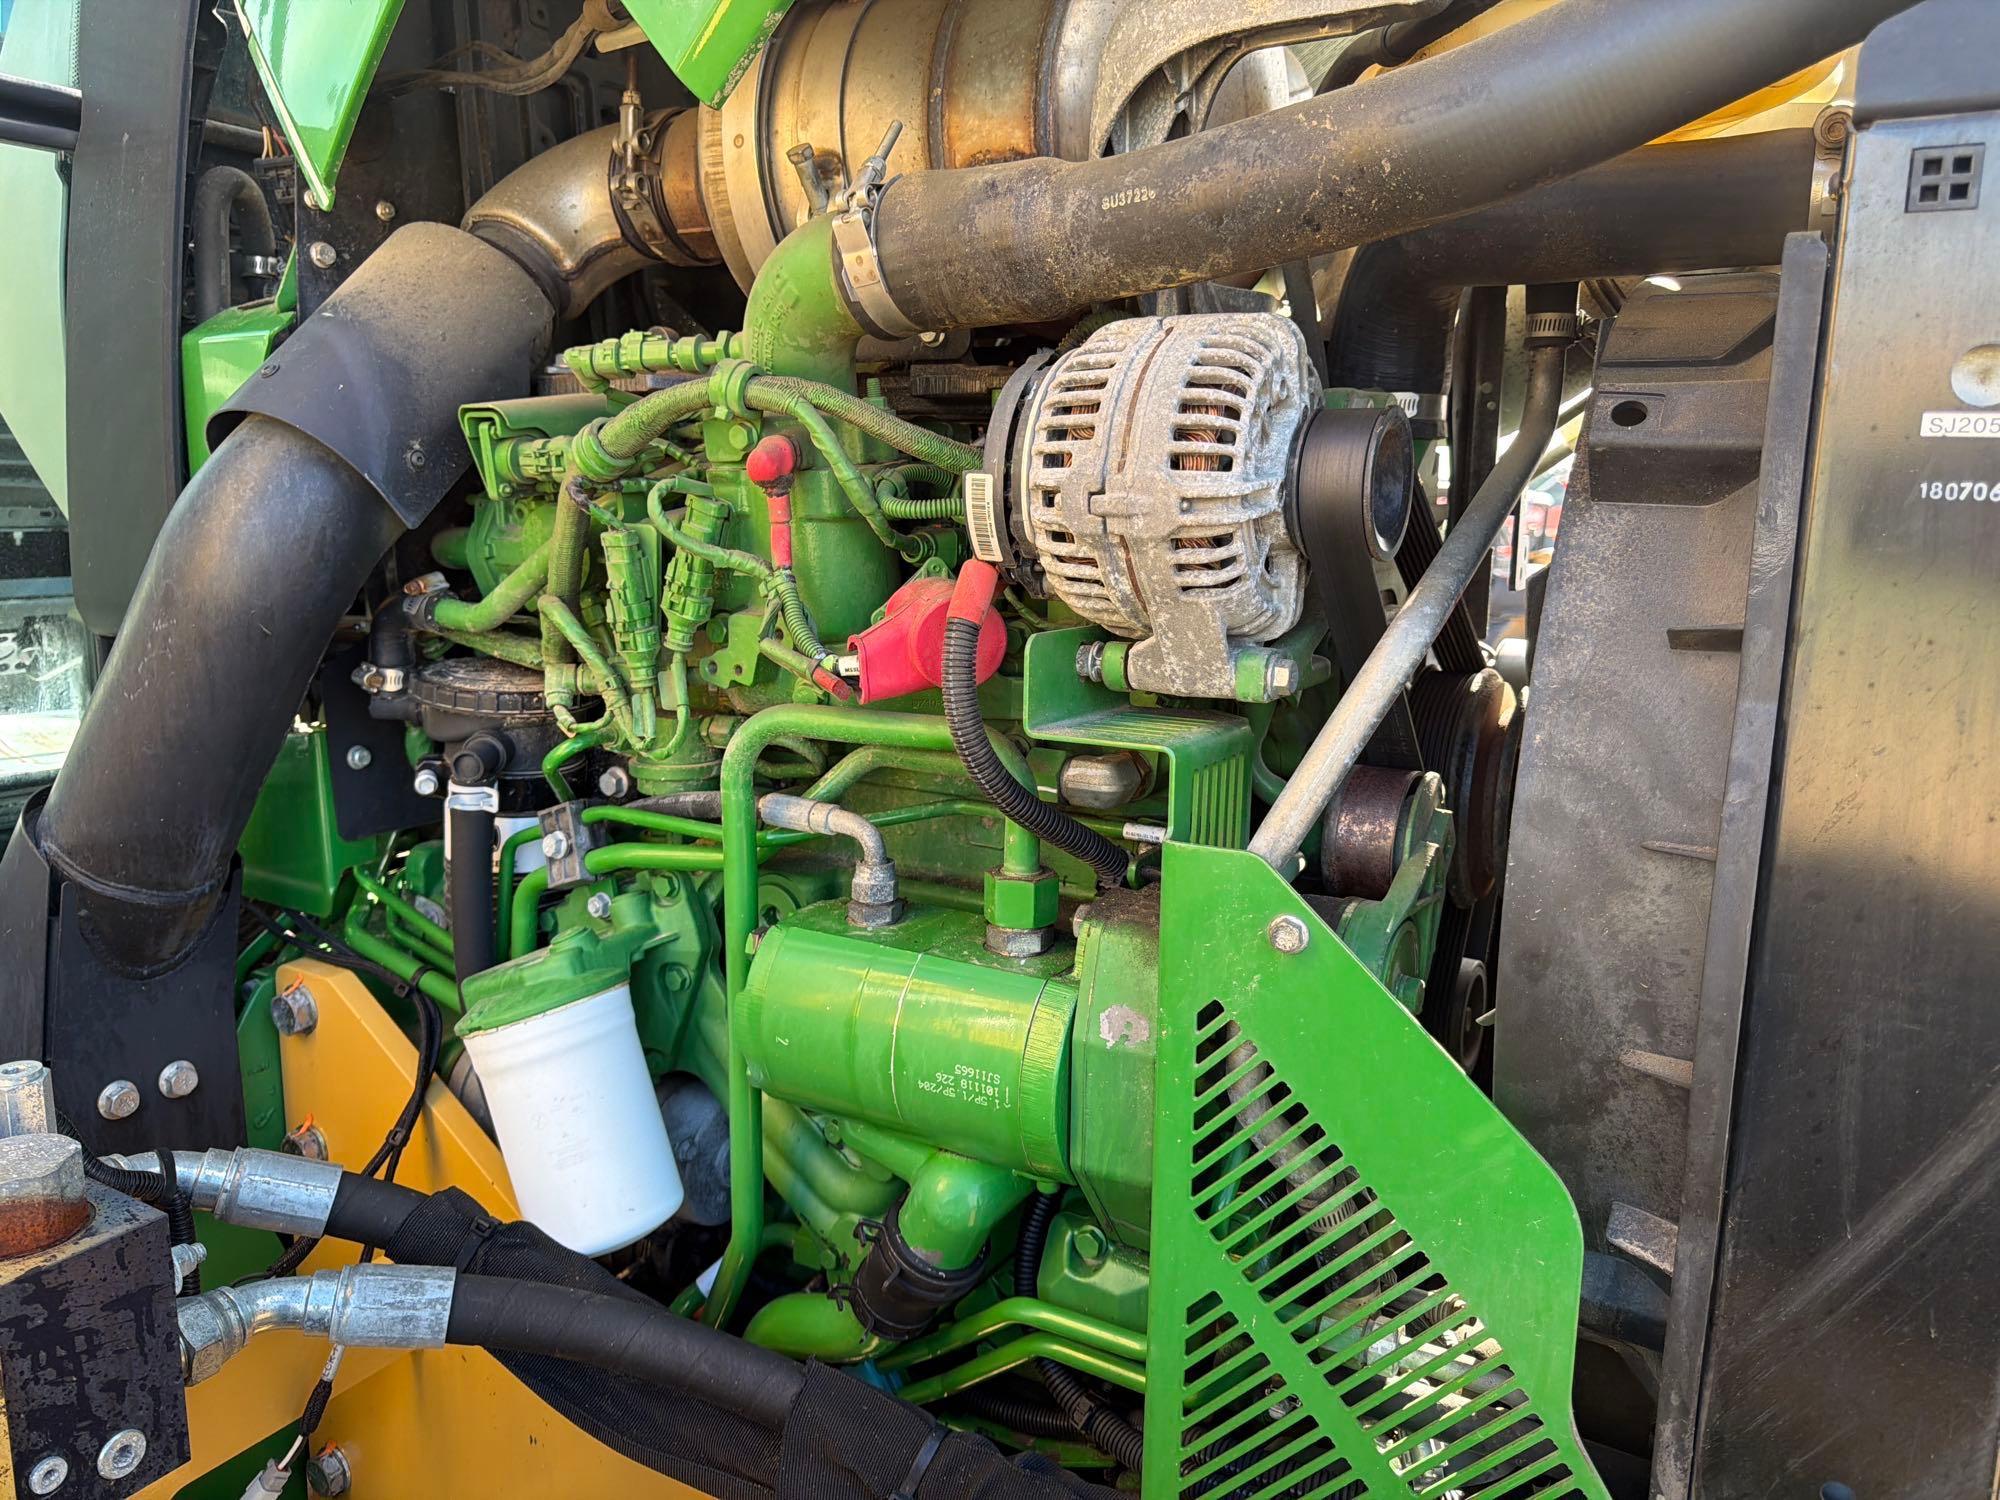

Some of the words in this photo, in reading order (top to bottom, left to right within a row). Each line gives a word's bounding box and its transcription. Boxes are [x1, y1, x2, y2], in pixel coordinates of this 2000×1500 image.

[1929, 417, 2000, 434] SJ205
[1920, 482, 2000, 502] 180706
[935, 1072, 955, 1086] 226
[954, 1064, 1001, 1085] SJ11665
[960, 1079, 999, 1098] 101118
